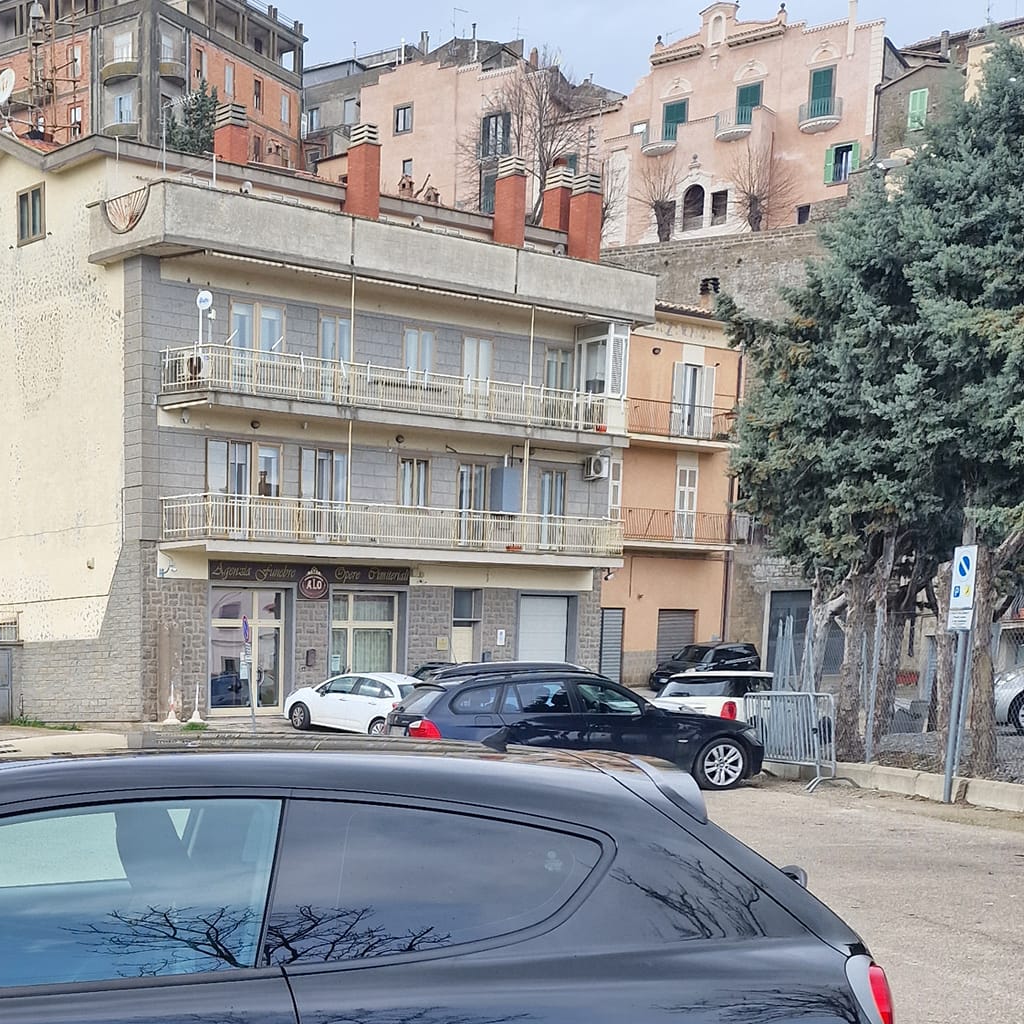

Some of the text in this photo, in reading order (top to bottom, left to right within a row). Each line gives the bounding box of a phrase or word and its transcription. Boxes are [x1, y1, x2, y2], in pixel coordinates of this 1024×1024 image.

[211, 561, 251, 580] Agenzia
[255, 564, 297, 581] Funebre
[334, 567, 361, 584] Opere
[306, 578, 322, 590] ALO
